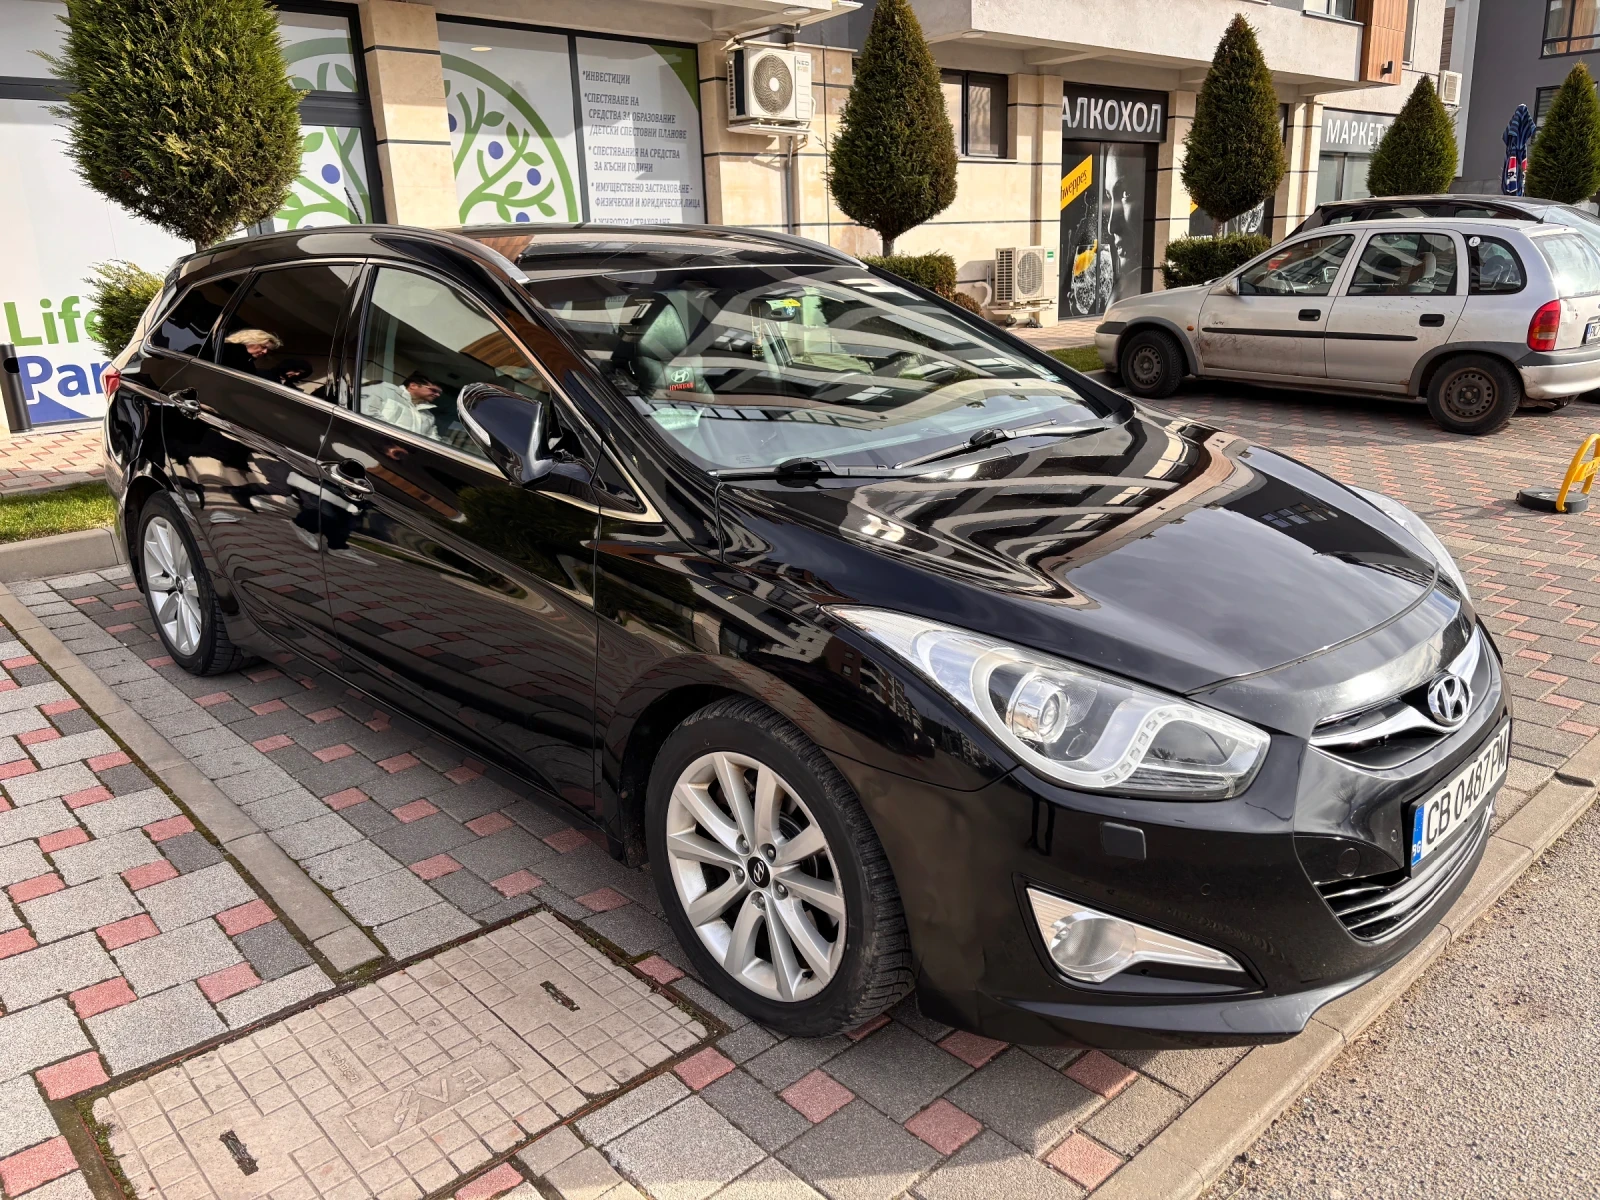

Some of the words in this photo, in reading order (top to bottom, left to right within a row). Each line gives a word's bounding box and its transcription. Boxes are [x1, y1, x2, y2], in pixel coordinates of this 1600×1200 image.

[584, 71, 631, 85] ИНВЕСТИЦИИ
[586, 92, 629, 105] СПЕСТЯВАНЕ
[630, 96, 640, 106] НА
[588, 109, 621, 121] СРЕДСТВА
[623, 111, 631, 121] ЗА
[632, 112, 676, 124] ОБРАЗОВАНИЕ
[1062, 95, 1161, 134] АЛКОХОЛ
[589, 124, 619, 136] /ДЕТСКИ
[620, 126, 657, 138] СПЕСТОВНИ
[658, 129, 687, 139] ПЛАНОВЕ
[1325, 118, 1384, 146] МАРКЕТ
[592, 146, 639, 157] СПЕСТЯВАНИЯ
[640, 148, 649, 158] НА
[649, 149, 680, 160] СРЕДСТВА
[594, 161, 603, 171] ЗА
[603, 162, 626, 172] КЪСНИ
[627, 162, 653, 174] ГОДИНИ
[595, 182, 644, 194] ИМУЩЕСТВЕНО
[644, 183, 690, 194] ЗАСТРАХОВАНЕ
[594, 197, 634, 207] ФИЗИЧЕСКИ
[635, 197, 640, 208] И
[641, 198, 683, 209] ЮРИДИЧЕСКИ
[683, 198, 701, 209] ЛИЦА
[1425, 790, 1451, 846] CB
[1453, 748, 1491, 821] 0487
